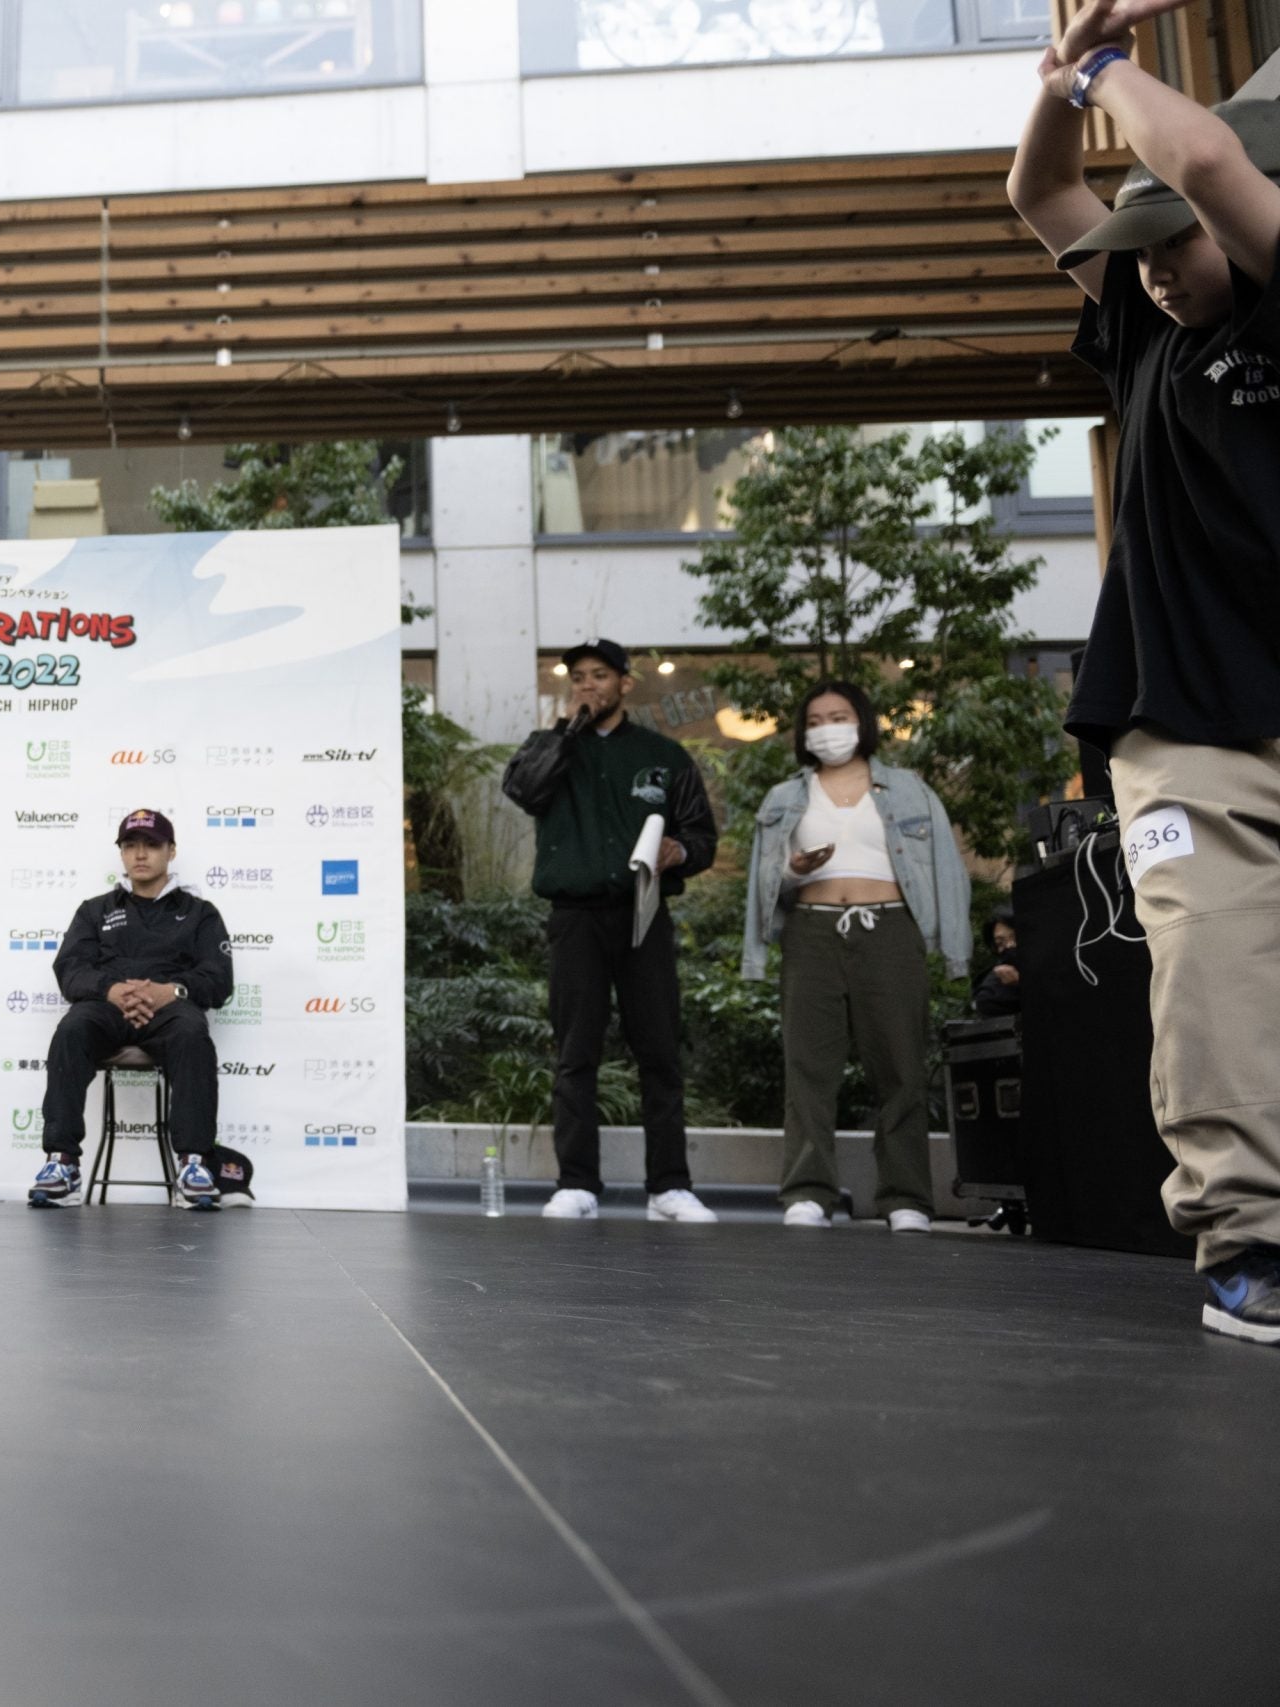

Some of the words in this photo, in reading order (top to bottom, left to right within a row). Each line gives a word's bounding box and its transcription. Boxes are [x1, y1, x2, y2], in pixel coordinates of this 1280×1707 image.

[28, 698, 79, 712] HIPHOP
[111, 750, 148, 765] au
[153, 749, 177, 765] 5G
[15, 810, 79, 822] Valuence
[206, 805, 275, 816] GoPro
[231, 868, 272, 881] 渋谷区
[9, 929, 67, 939] GoPr
[228, 933, 273, 944] uence
[305, 997, 346, 1013] au
[349, 997, 376, 1013] 5G
[131, 1071, 158, 1079] NIPPO
[112, 1080, 158, 1088] FOUNDATIO
[114, 1119, 158, 1133] aluenc
[304, 1124, 377, 1135] GoPro
